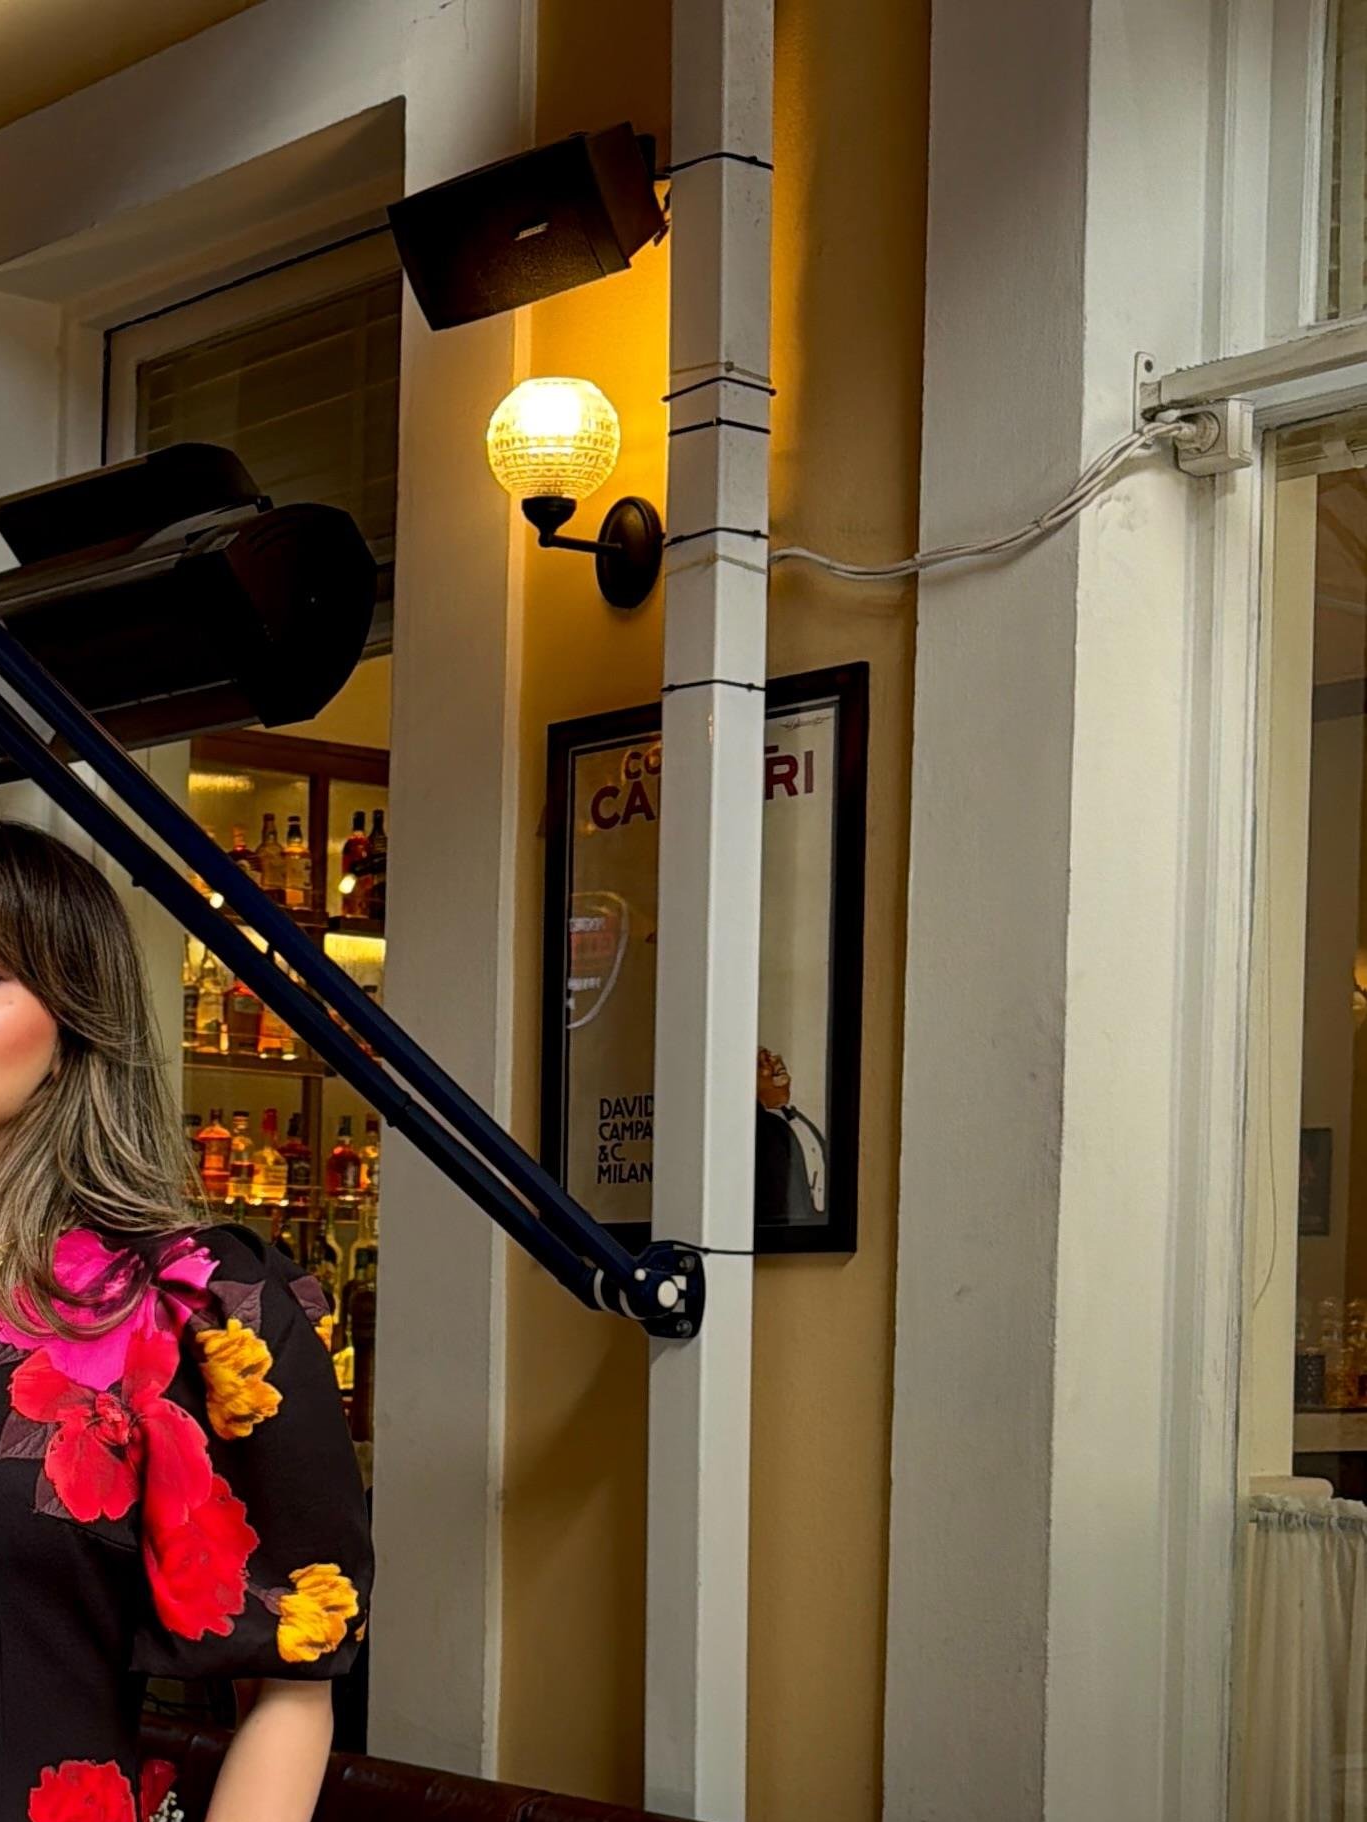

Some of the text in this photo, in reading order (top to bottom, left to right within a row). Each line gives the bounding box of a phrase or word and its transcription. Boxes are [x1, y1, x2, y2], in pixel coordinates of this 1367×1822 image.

[590, 749, 815, 831] CARI
[599, 1094, 654, 1120] DAVID
[598, 1120, 653, 1142] CAMPA
[597, 1162, 653, 1185] MILAN
